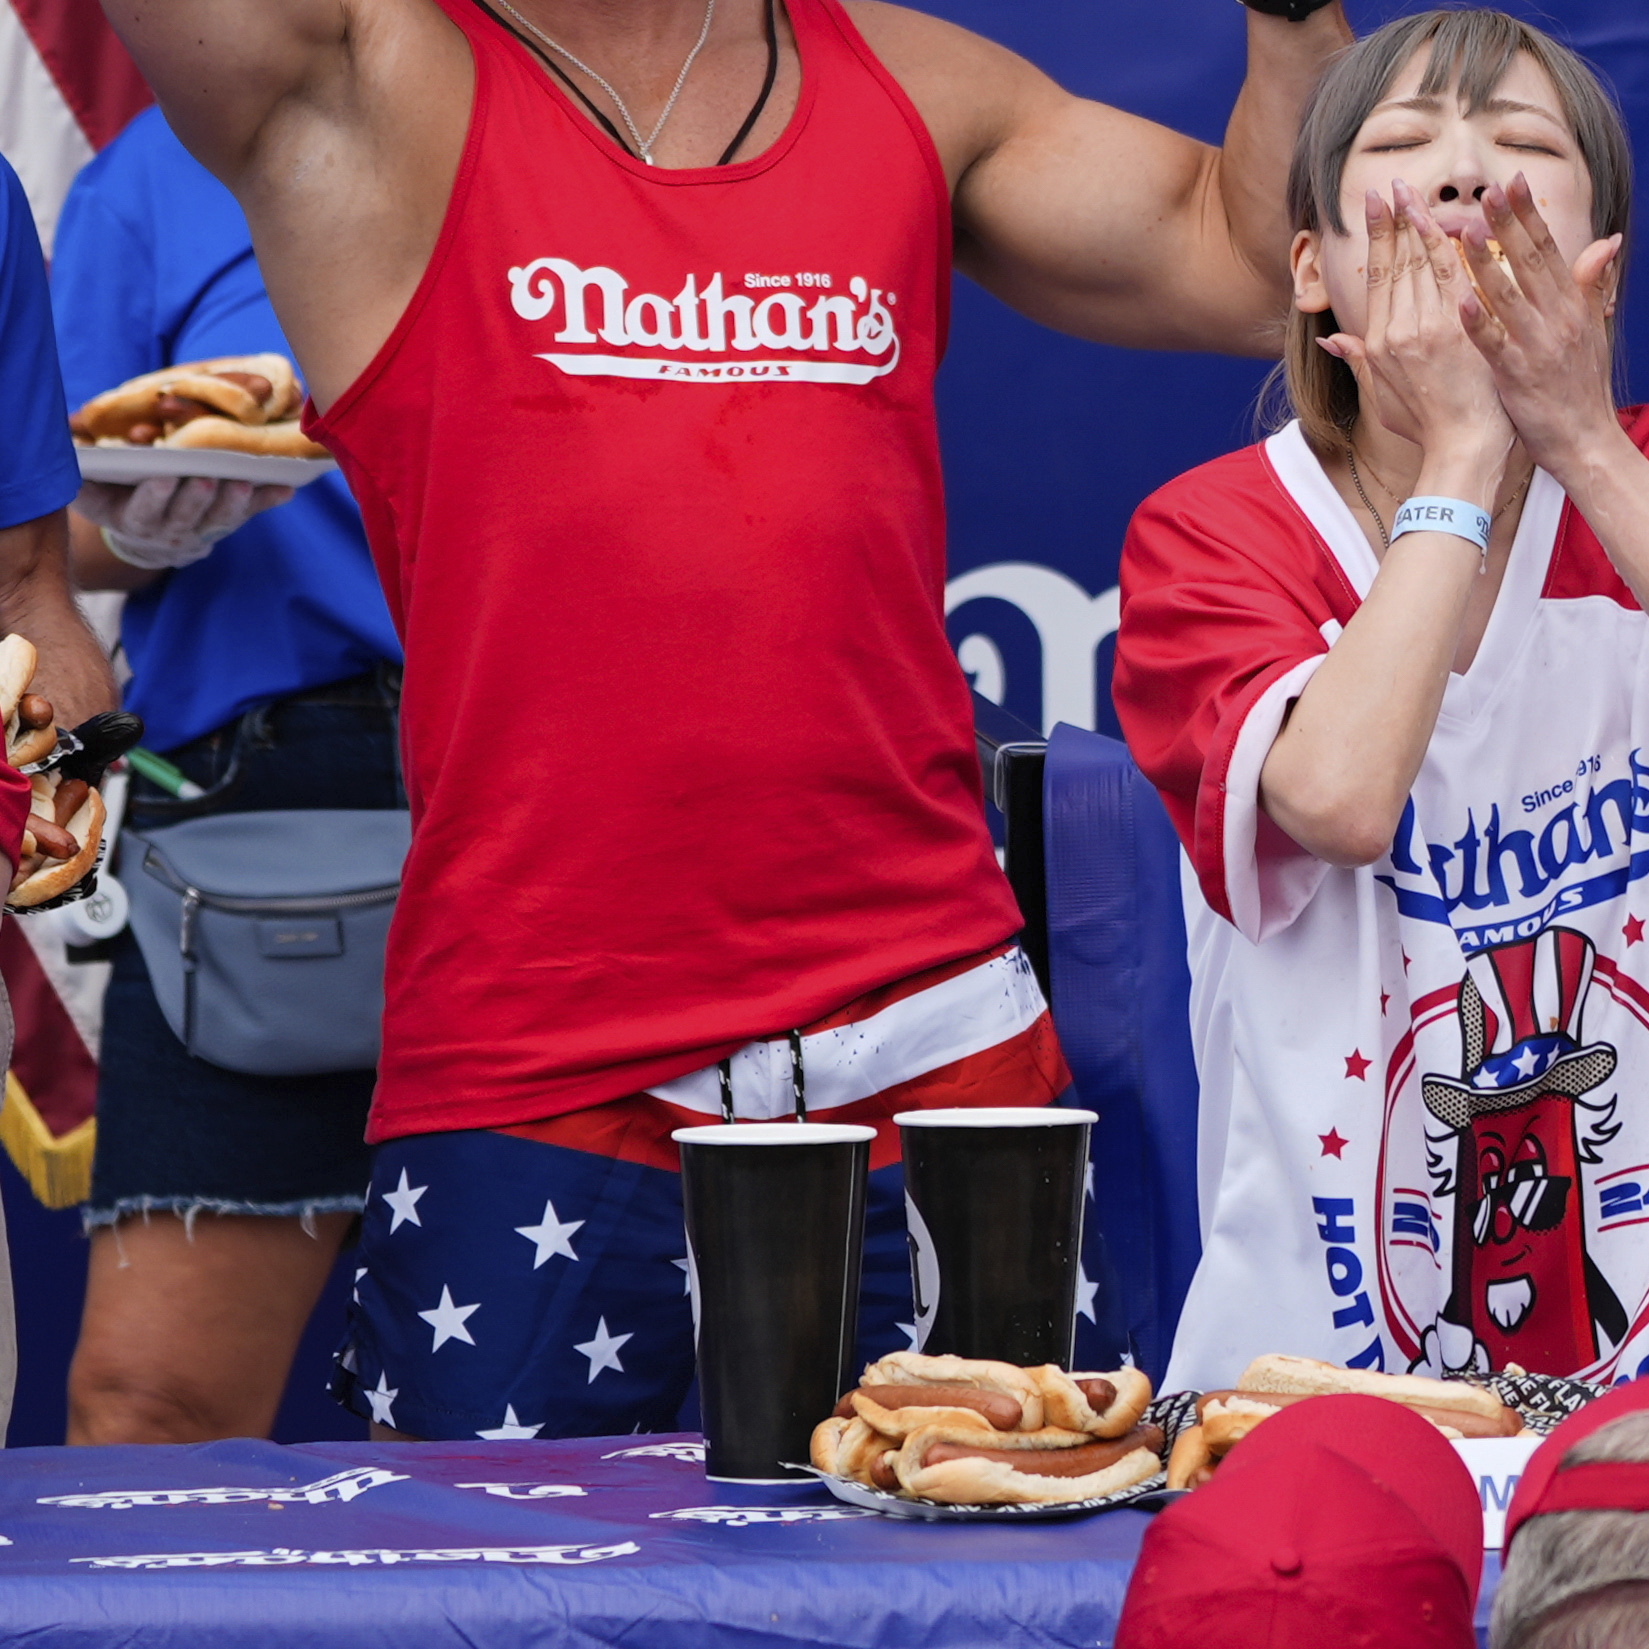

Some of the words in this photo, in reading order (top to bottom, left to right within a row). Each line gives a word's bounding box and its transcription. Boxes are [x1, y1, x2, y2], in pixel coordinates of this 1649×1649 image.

[744, 272, 791, 289] Since
[796, 272, 832, 288] 1916
[507, 257, 900, 370] Nathan's
[658, 364, 792, 377] FAMOUS
[1521, 779, 1574, 813] Since
[1460, 887, 1585, 948] AMOUS
[1311, 1195, 1376, 1331] HOT
